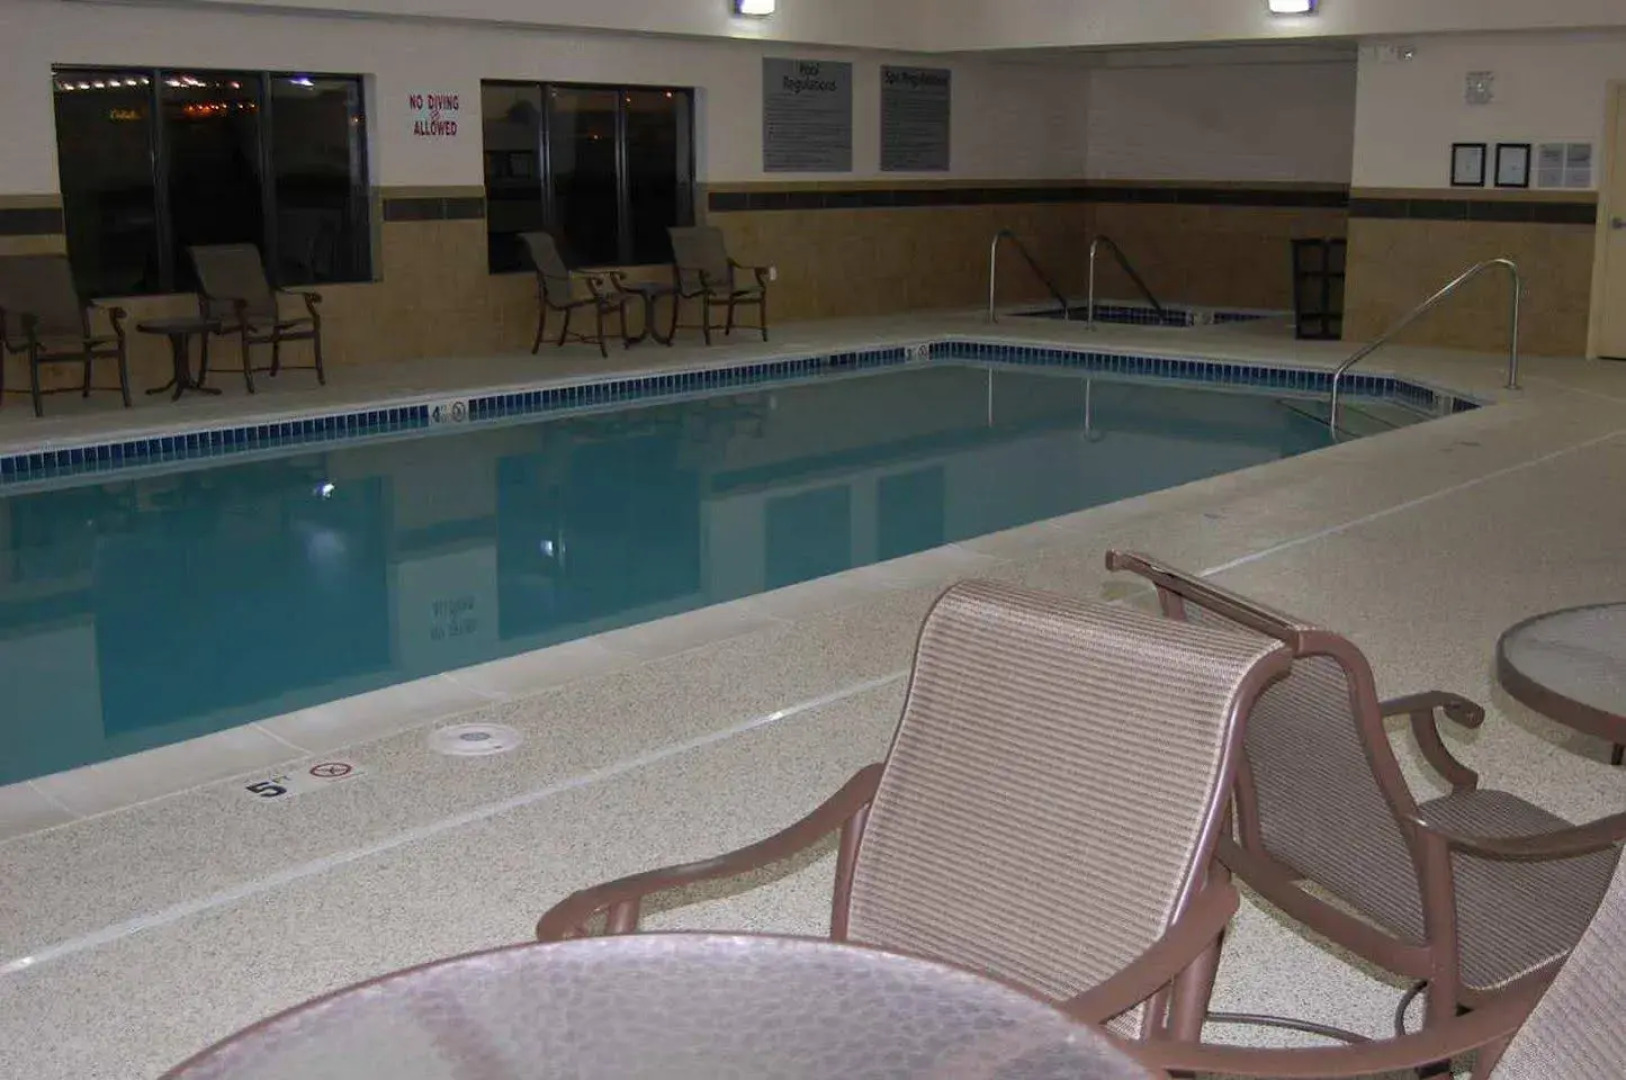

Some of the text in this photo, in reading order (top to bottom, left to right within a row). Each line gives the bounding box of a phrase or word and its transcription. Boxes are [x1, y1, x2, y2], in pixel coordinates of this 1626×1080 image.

[799, 61, 820, 76] Pool
[783, 75, 837, 94] Regulations
[410, 94, 459, 110] NO DIVING
[414, 120, 457, 136] ALLOWED
